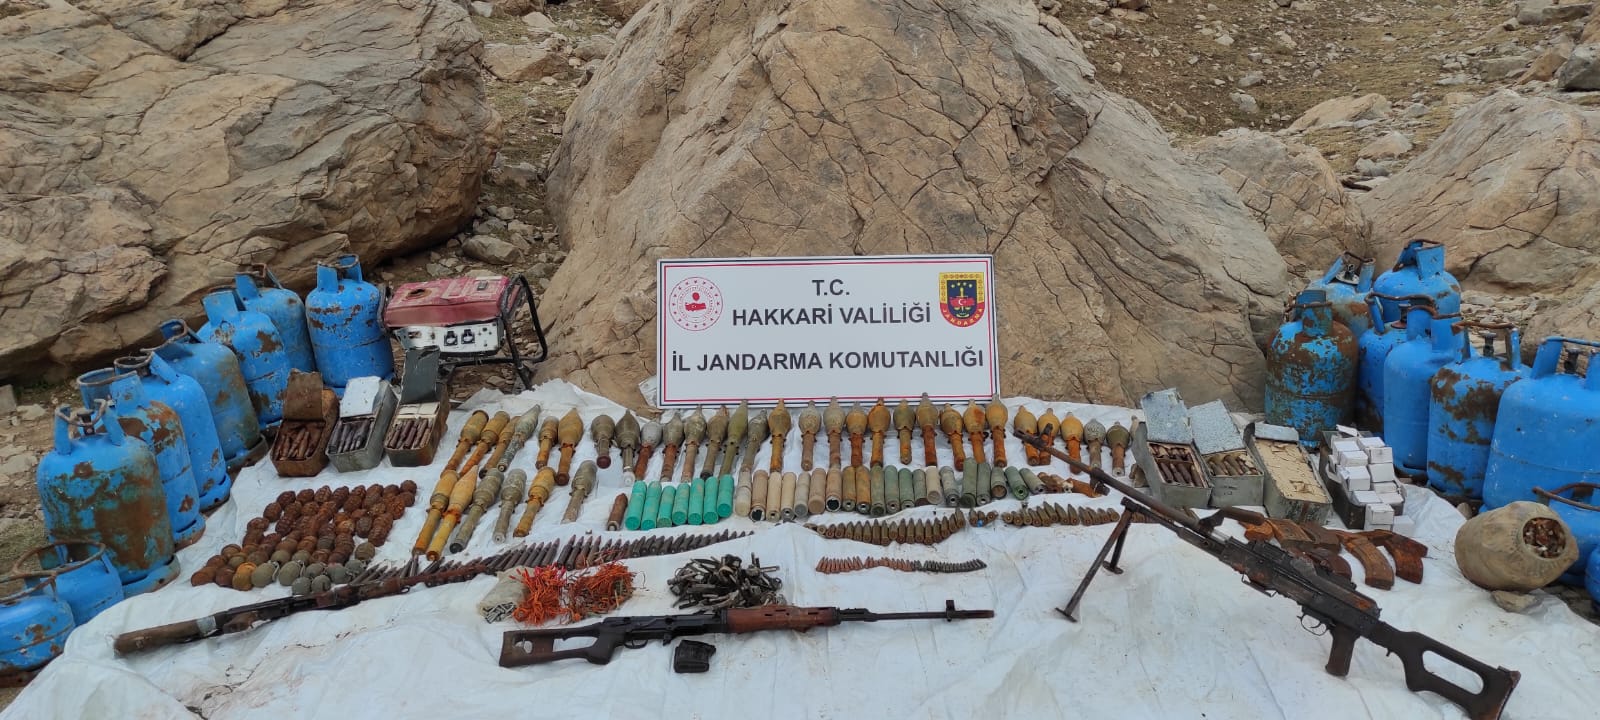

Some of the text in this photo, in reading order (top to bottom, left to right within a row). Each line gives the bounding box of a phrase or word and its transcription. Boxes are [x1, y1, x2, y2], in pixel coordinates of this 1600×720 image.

[811, 279, 850, 296] T.C.
[732, 303, 833, 326] HAKKARİ
[839, 302, 931, 324] VALİLİĞİ
[672, 345, 984, 372] İL JANDARMA KOMUTANLIĞI
